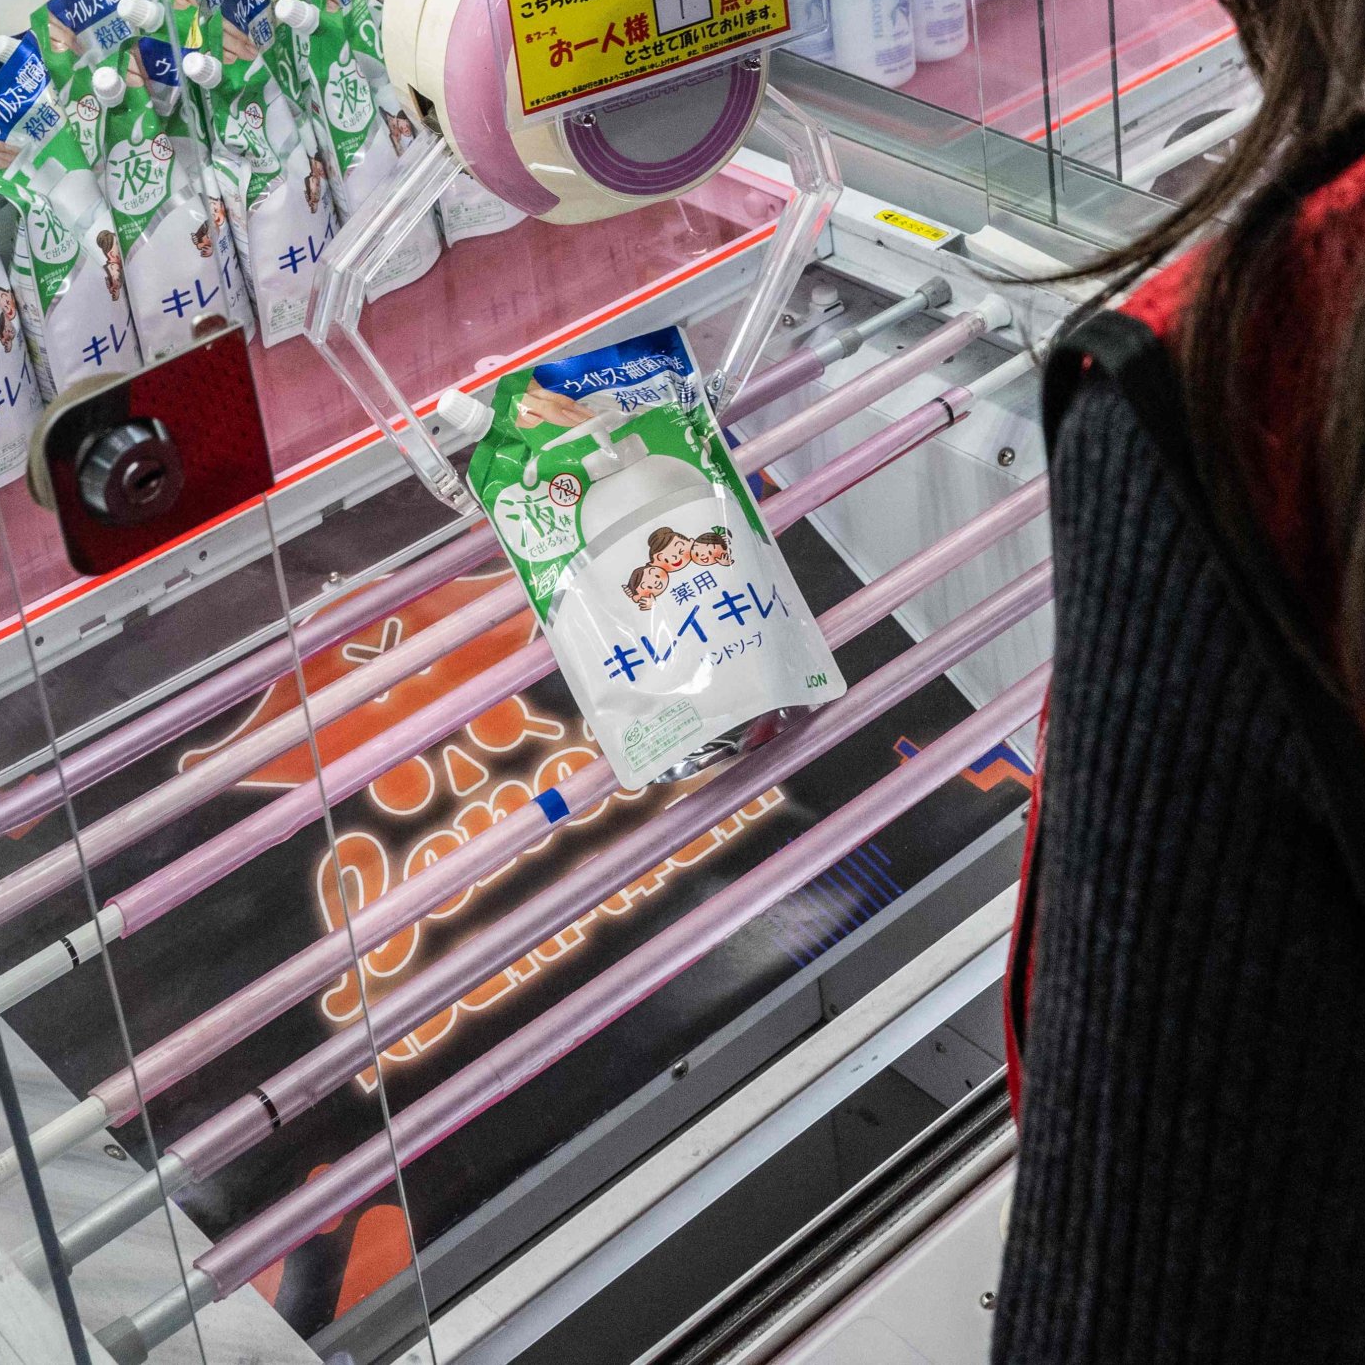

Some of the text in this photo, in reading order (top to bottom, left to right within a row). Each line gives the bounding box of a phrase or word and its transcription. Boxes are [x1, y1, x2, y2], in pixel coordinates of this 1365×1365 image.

[549, 14, 650, 67] お一人様
[624, 5, 777, 65] とさせて頂いております。
[671, 570, 718, 606] 薬用
[806, 673, 828, 688] LON
